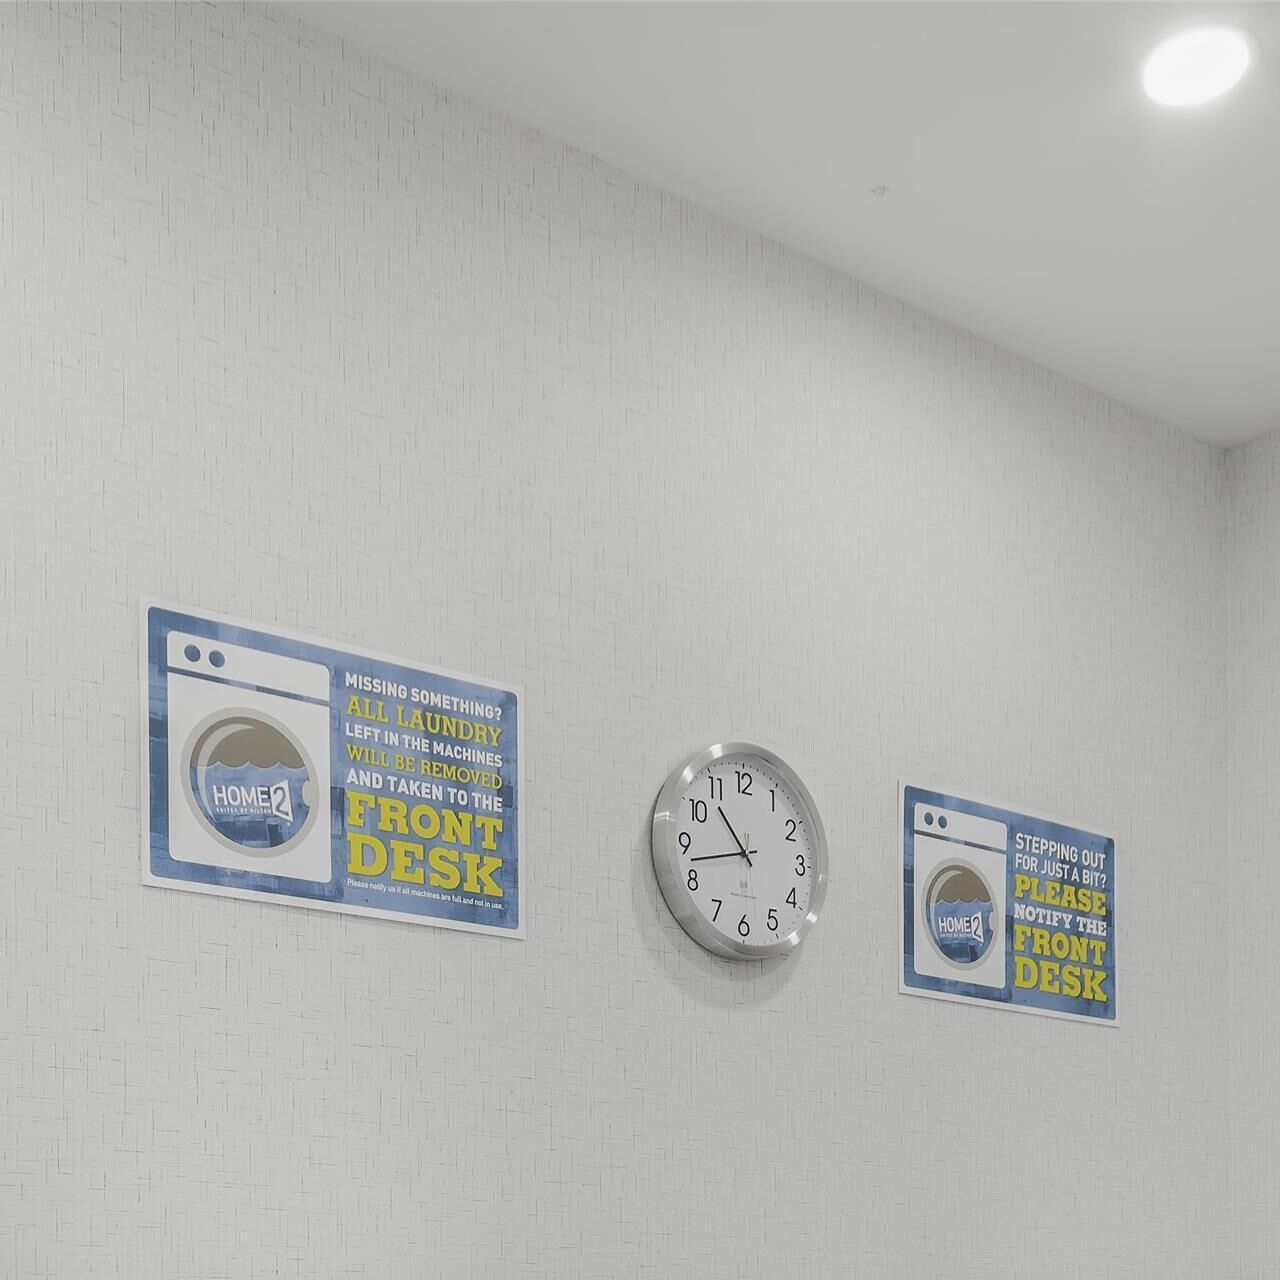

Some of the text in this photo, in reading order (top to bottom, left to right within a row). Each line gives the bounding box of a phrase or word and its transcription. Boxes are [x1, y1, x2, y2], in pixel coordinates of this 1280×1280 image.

[345, 672, 503, 721] MISSING SOMETHING?
[346, 695, 503, 747] ALL LAUNDRY
[345, 722, 503, 768] LEFT IN THE MACHINES
[346, 743, 503, 790] WILL BE REMOVED
[347, 768, 503, 813] AND TAKEN TO THE
[708, 776, 723, 801] 11
[735, 771, 753, 796] 12
[689, 798, 708, 824] 10
[769, 789, 775, 812] 1
[346, 790, 503, 851] FRONT
[785, 819, 797, 842] 2
[678, 831, 692, 855] 9
[1016, 832, 1106, 870] STEPPING OUT
[346, 831, 504, 898] DESK
[687, 869, 699, 891] 8
[795, 854, 806, 877] 3
[1015, 853, 1107, 888] FOR JUST A BIT?
[347, 878, 369, 889] Please
[369, 882, 387, 892] notify
[396, 886, 402, 894] if
[401, 887, 410, 895] all
[410, 889, 440, 900] machines
[441, 894, 452, 902] are
[452, 895, 462, 903] full
[474, 899, 484, 907] not
[485, 900, 491, 908] in
[491, 902, 504, 910] use.
[711, 898, 723, 922] 7
[785, 887, 797, 909] 4
[1014, 873, 1106, 916] PLEASE
[737, 914, 750, 937] 6
[766, 908, 779, 931] 5
[1013, 902, 1107, 937] NOTIFY THE
[1013, 923, 1106, 966] FRONT
[1014, 955, 1108, 1002] DESK
